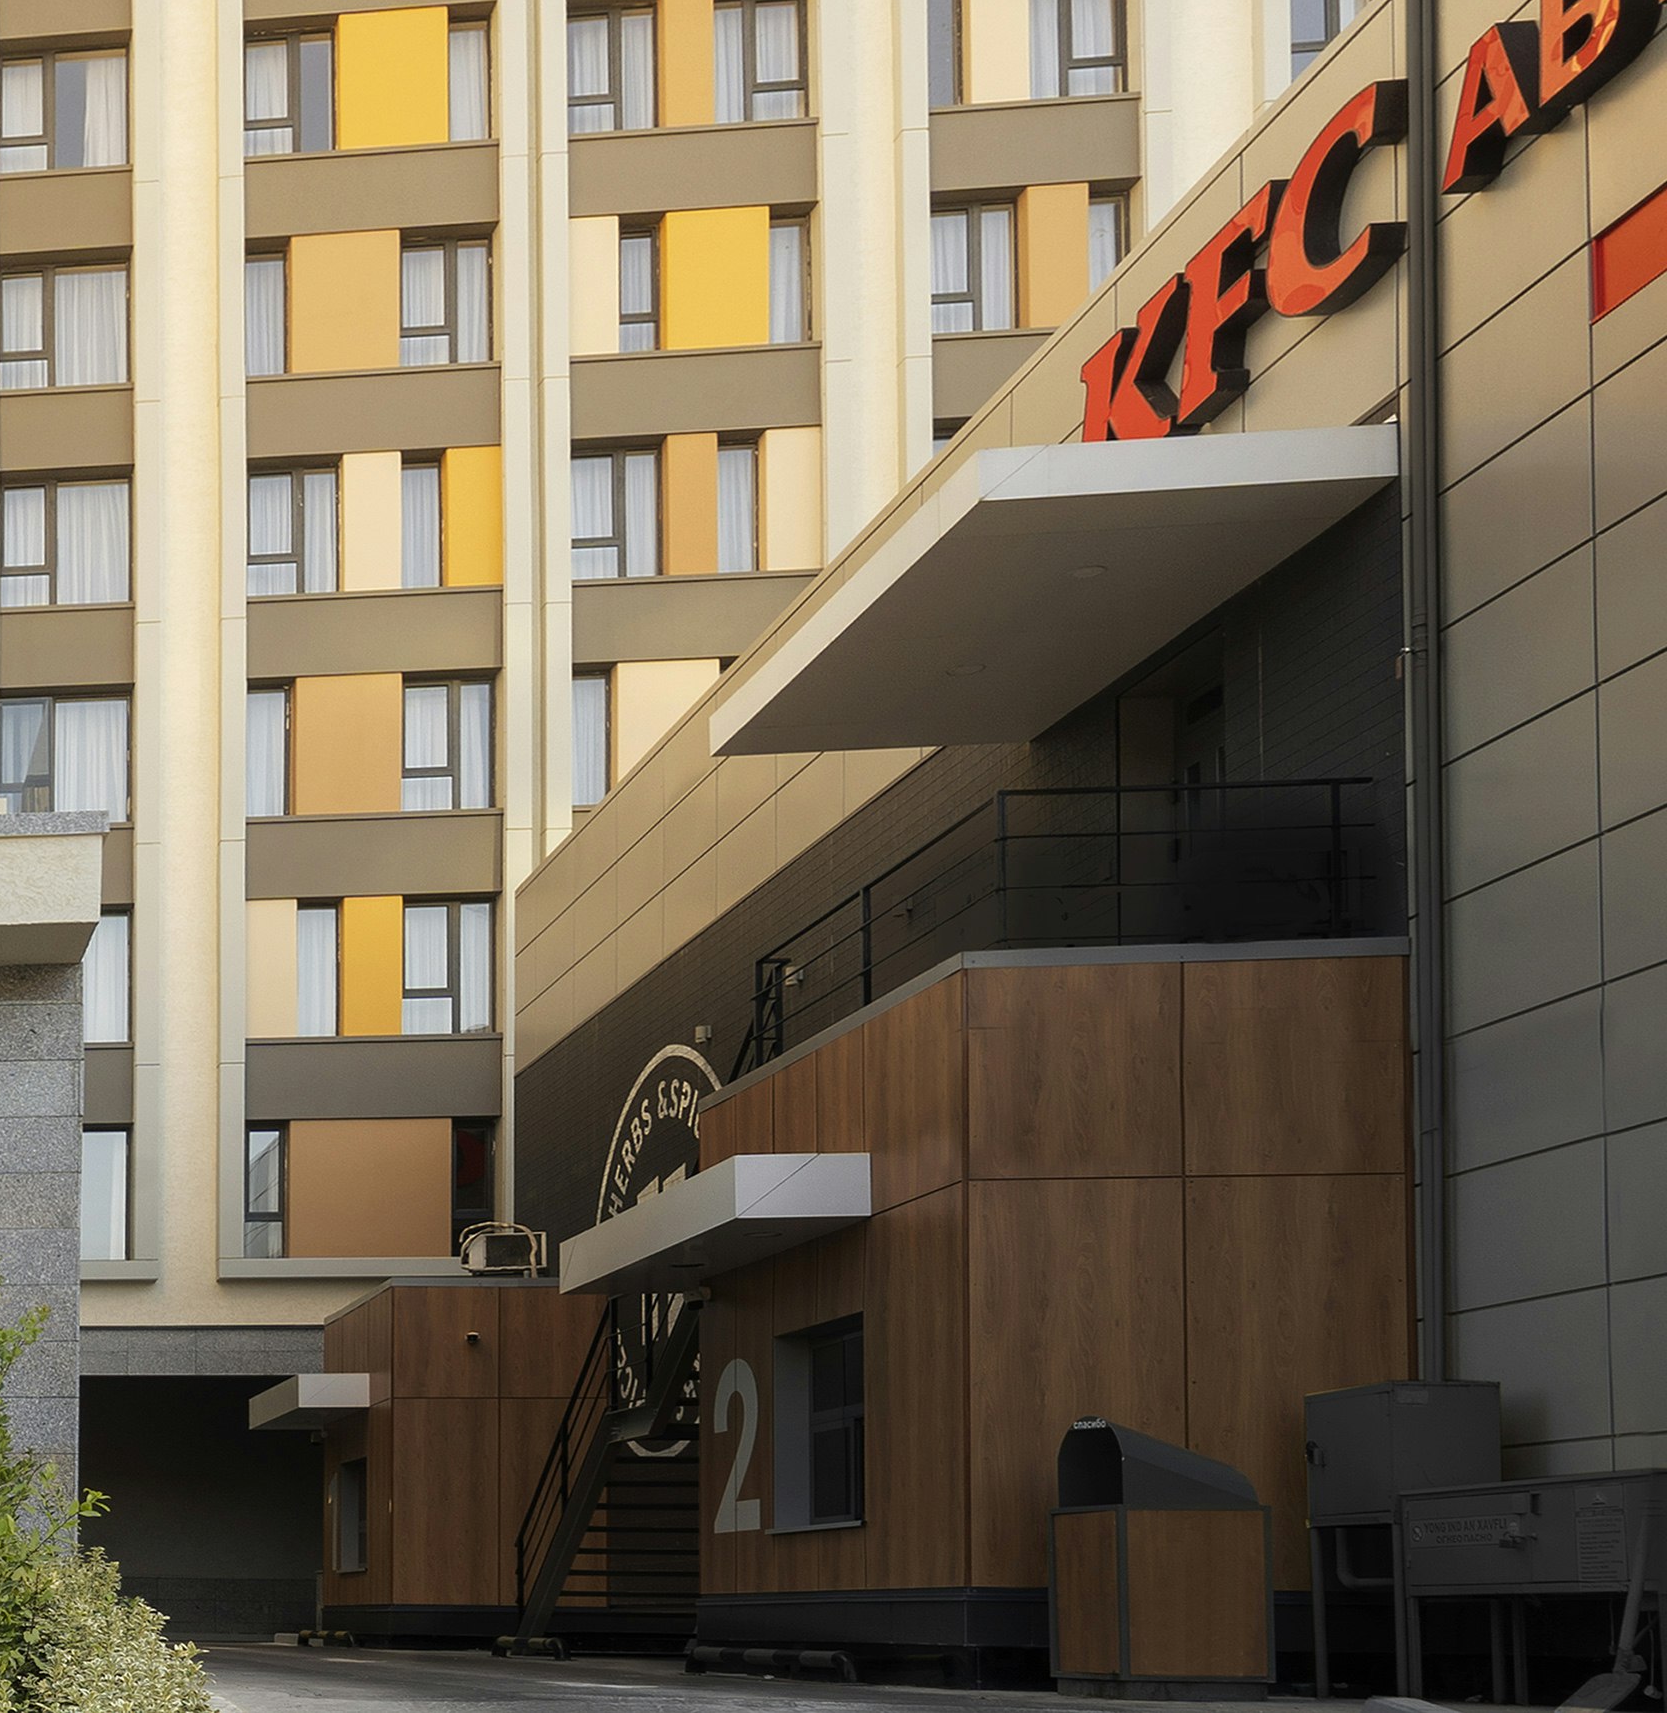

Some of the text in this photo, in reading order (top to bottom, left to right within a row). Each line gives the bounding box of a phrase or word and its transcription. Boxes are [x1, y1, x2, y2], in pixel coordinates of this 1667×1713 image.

[1080, 79, 1407, 443] KFC
[607, 1098, 652, 1217] HERBS
[669, 1078, 700, 1140] SPI
[714, 1359, 761, 1534] 2
[1073, 1418, 1106, 1430] спасибо
